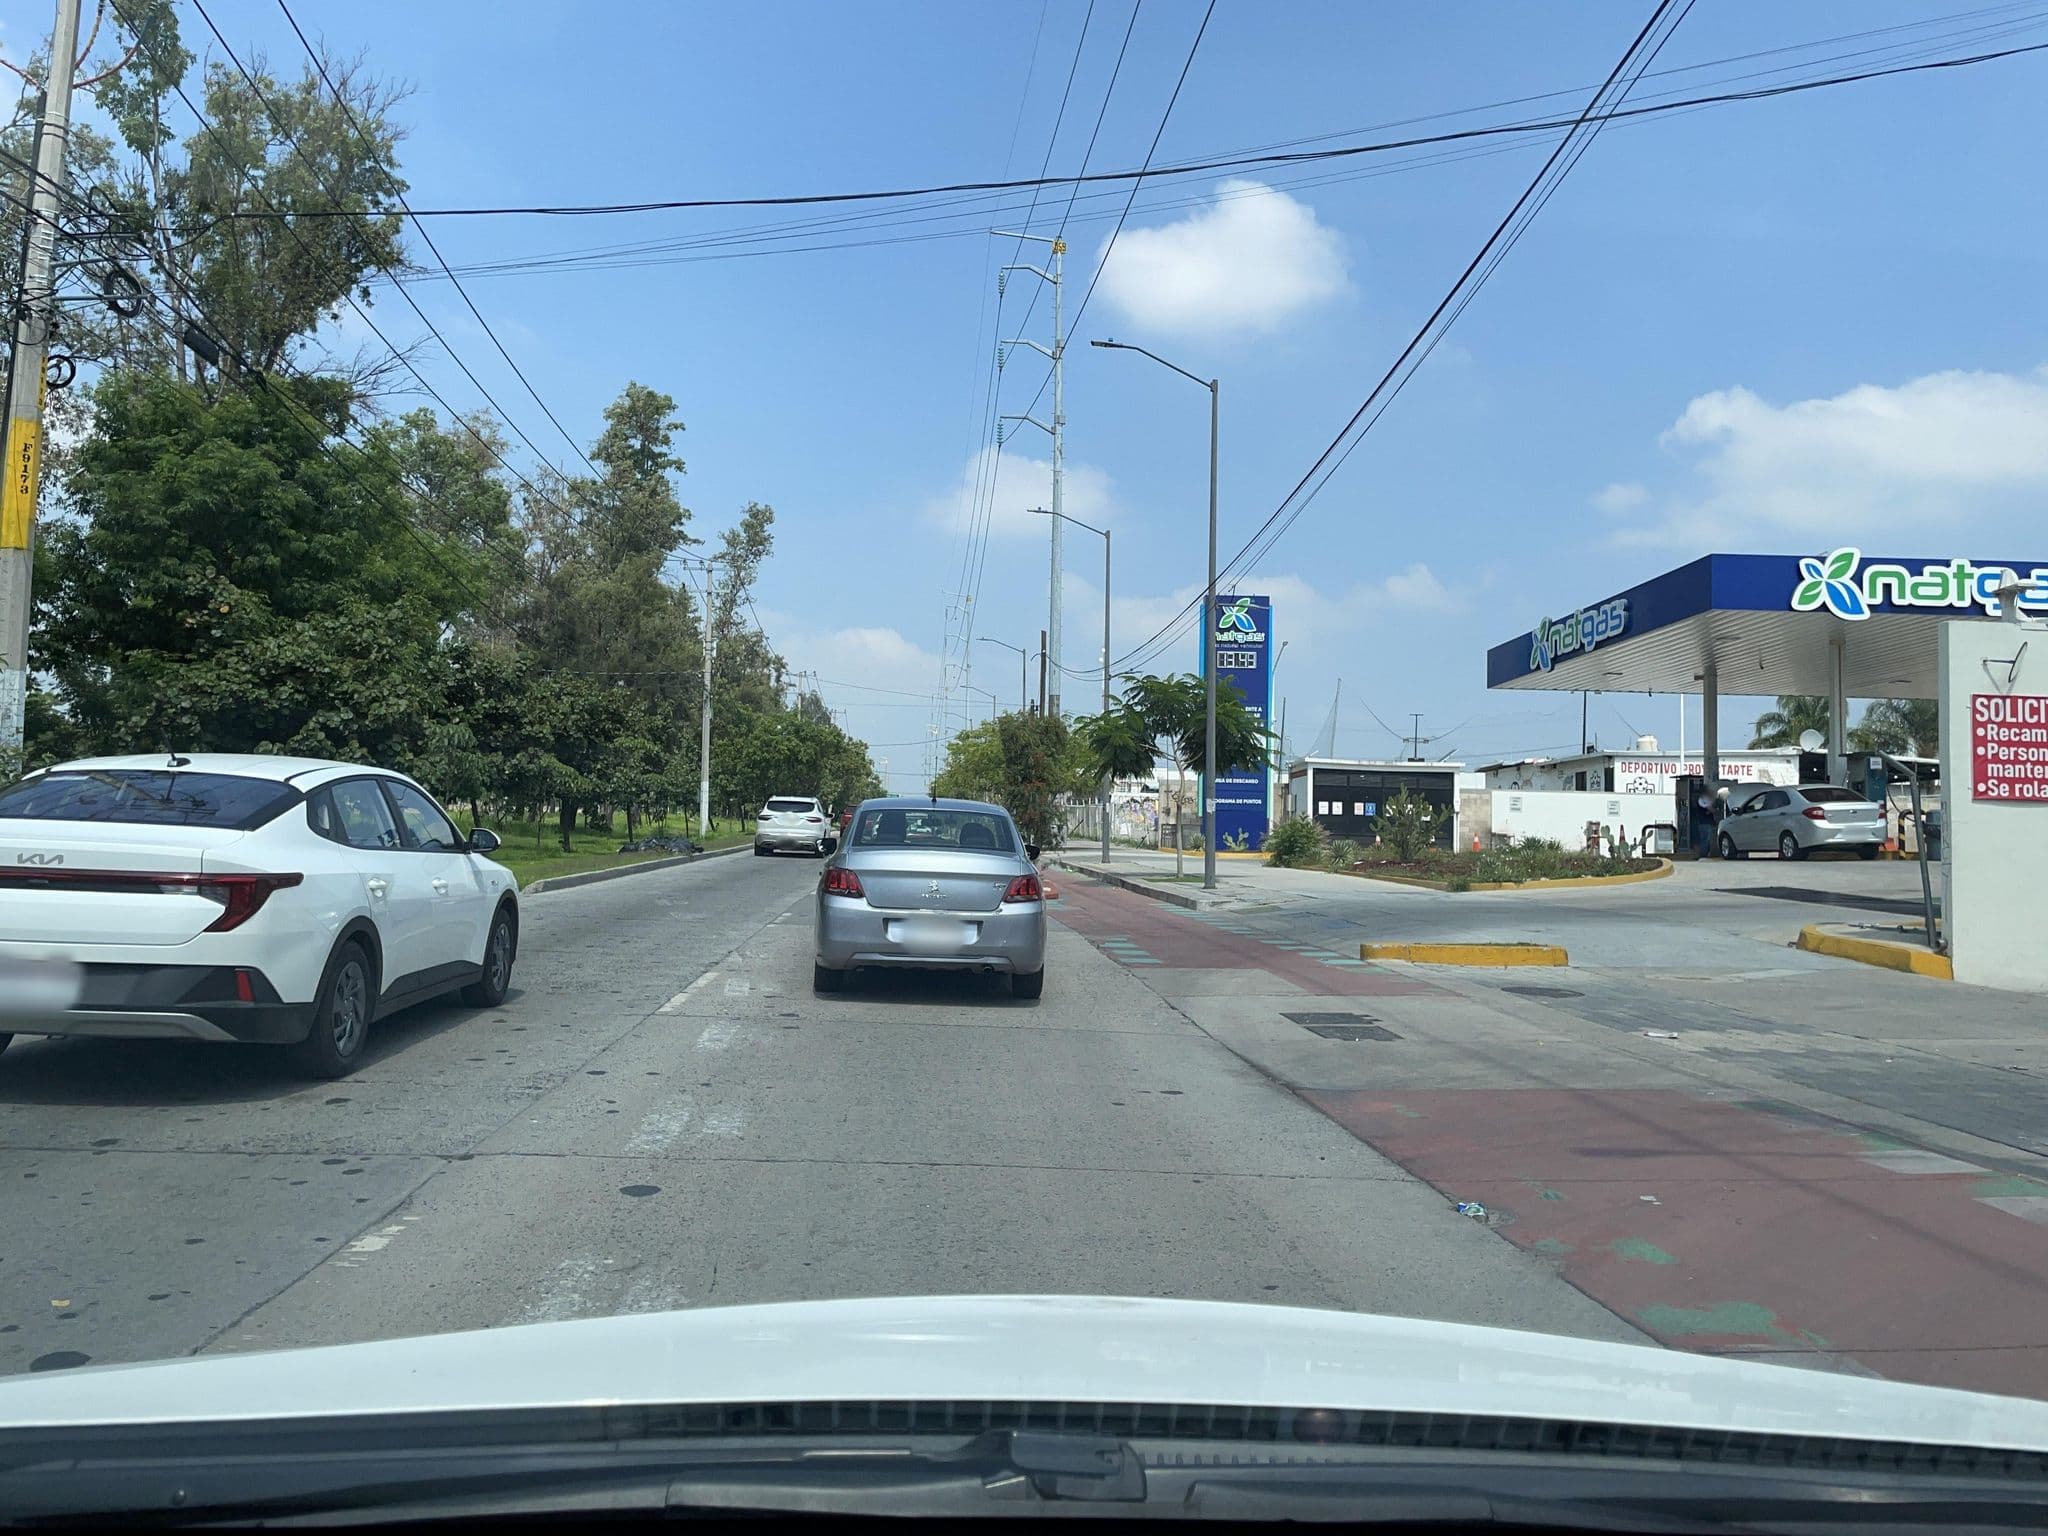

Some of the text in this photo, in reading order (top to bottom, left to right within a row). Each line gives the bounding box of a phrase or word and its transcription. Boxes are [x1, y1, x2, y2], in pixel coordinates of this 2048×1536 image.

[20, 443, 33, 495] F9173
[1549, 600, 1625, 651] natgas
[1975, 697, 2048, 723] SOLICI
[1621, 762, 1677, 775] DEPORTIVO
[1987, 779, 2009, 796] Se
[17, 853, 64, 865] KIA
